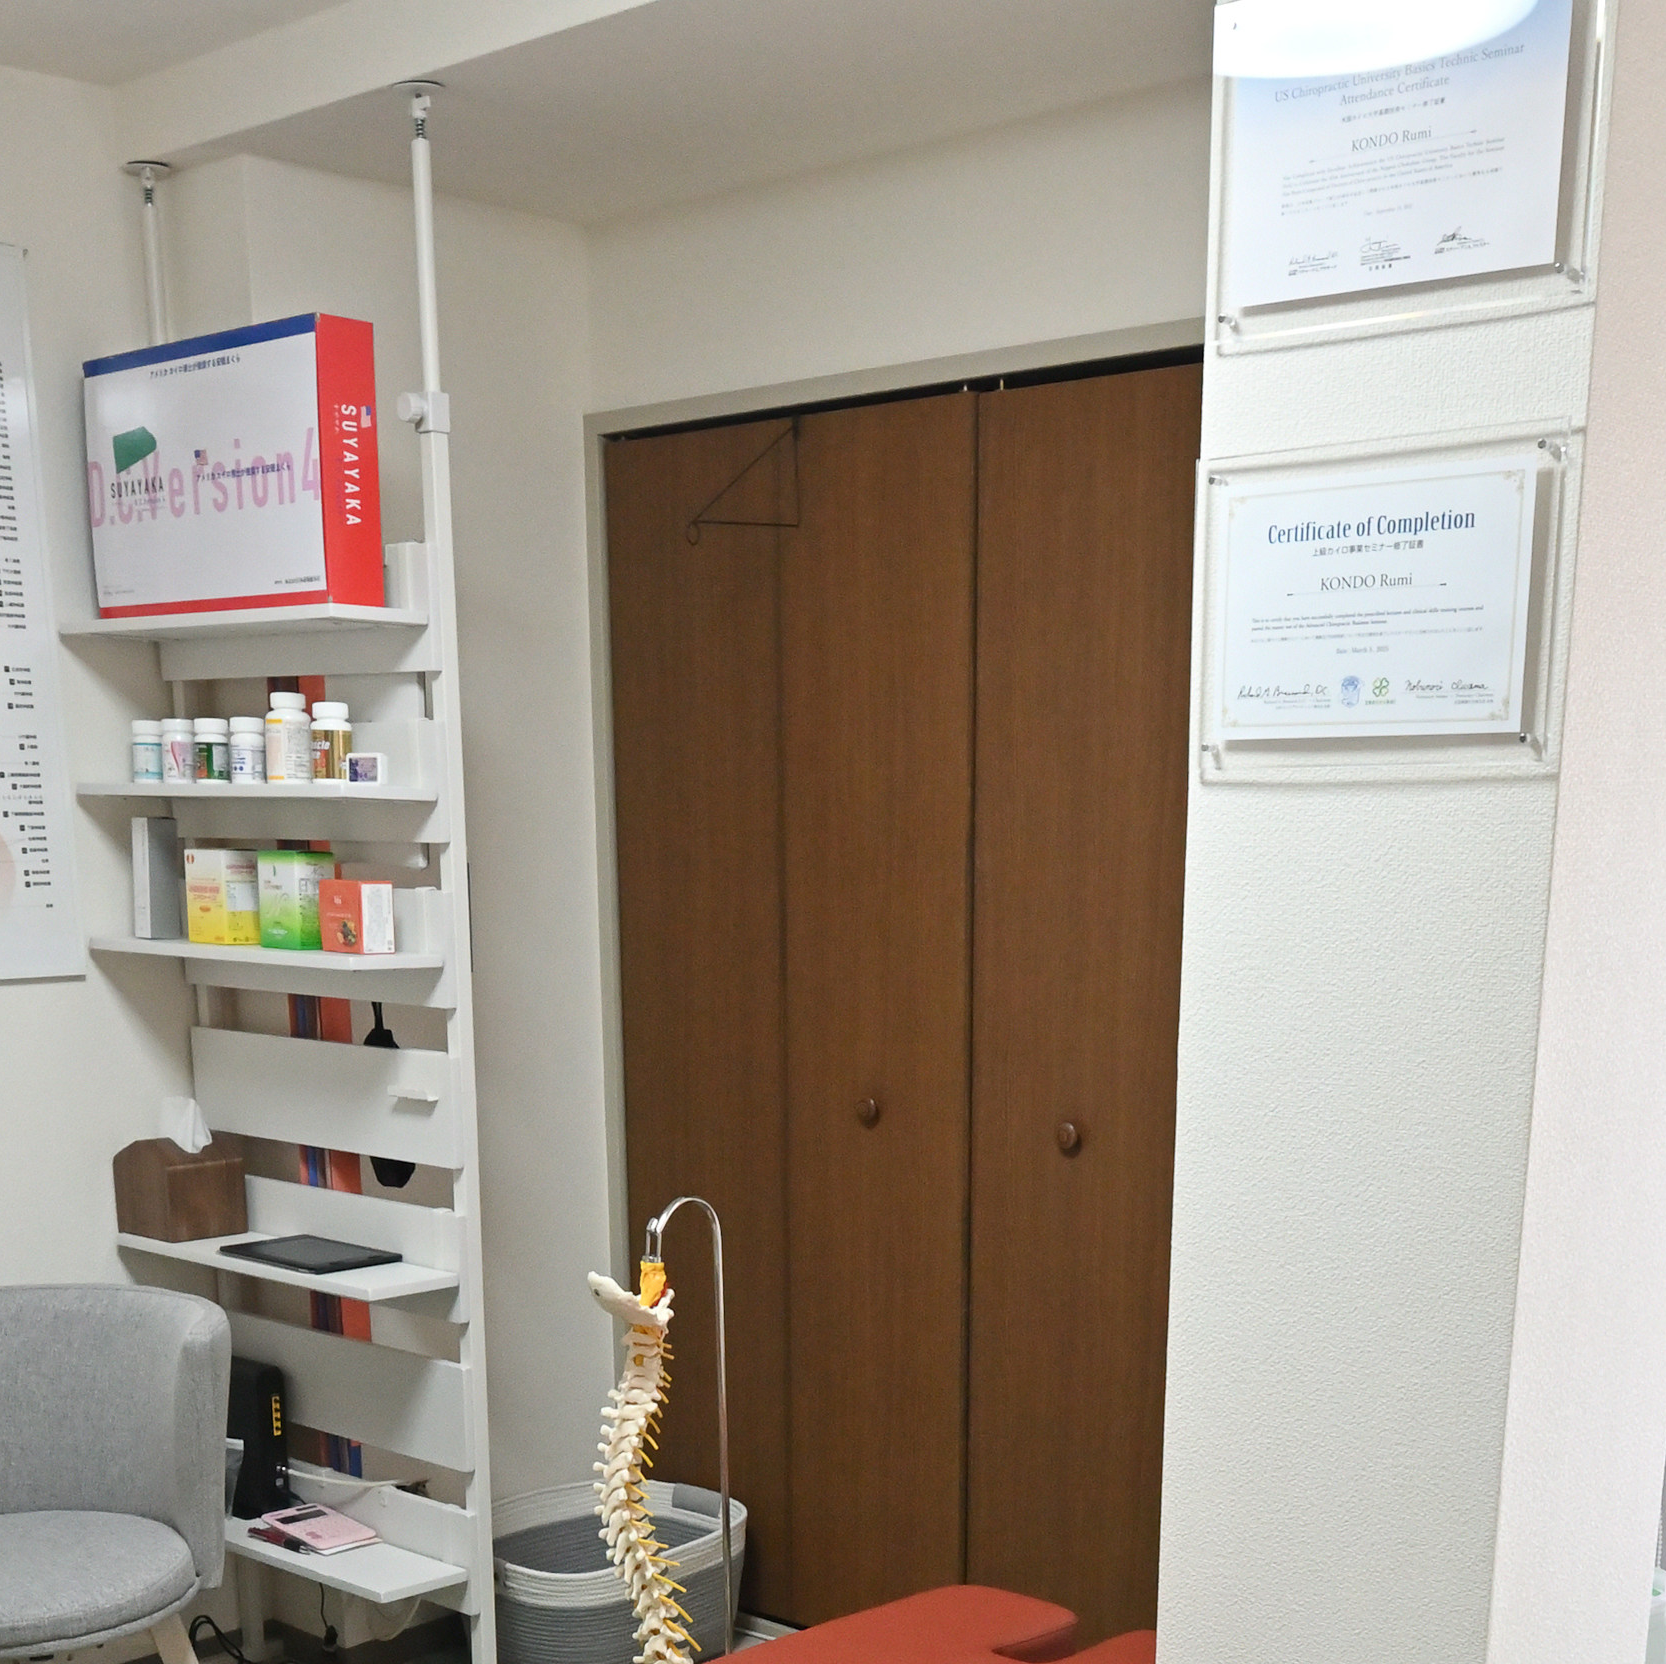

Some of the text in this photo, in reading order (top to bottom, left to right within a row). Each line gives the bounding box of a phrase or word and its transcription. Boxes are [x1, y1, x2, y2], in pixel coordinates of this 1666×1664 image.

[1275, 44, 1525, 102] US Chiropractic University Basics Technic Seminar
[1339, 75, 1450, 106] Attendance Certificate
[1351, 126, 1432, 152] KONDO Rumi
[341, 404, 361, 525] SUYAYAKA
[111, 476, 164, 499] SUYAYAKA
[1269, 510, 1475, 544] Certificate of Completion
[1320, 572, 1412, 591] KONDO Rumi
